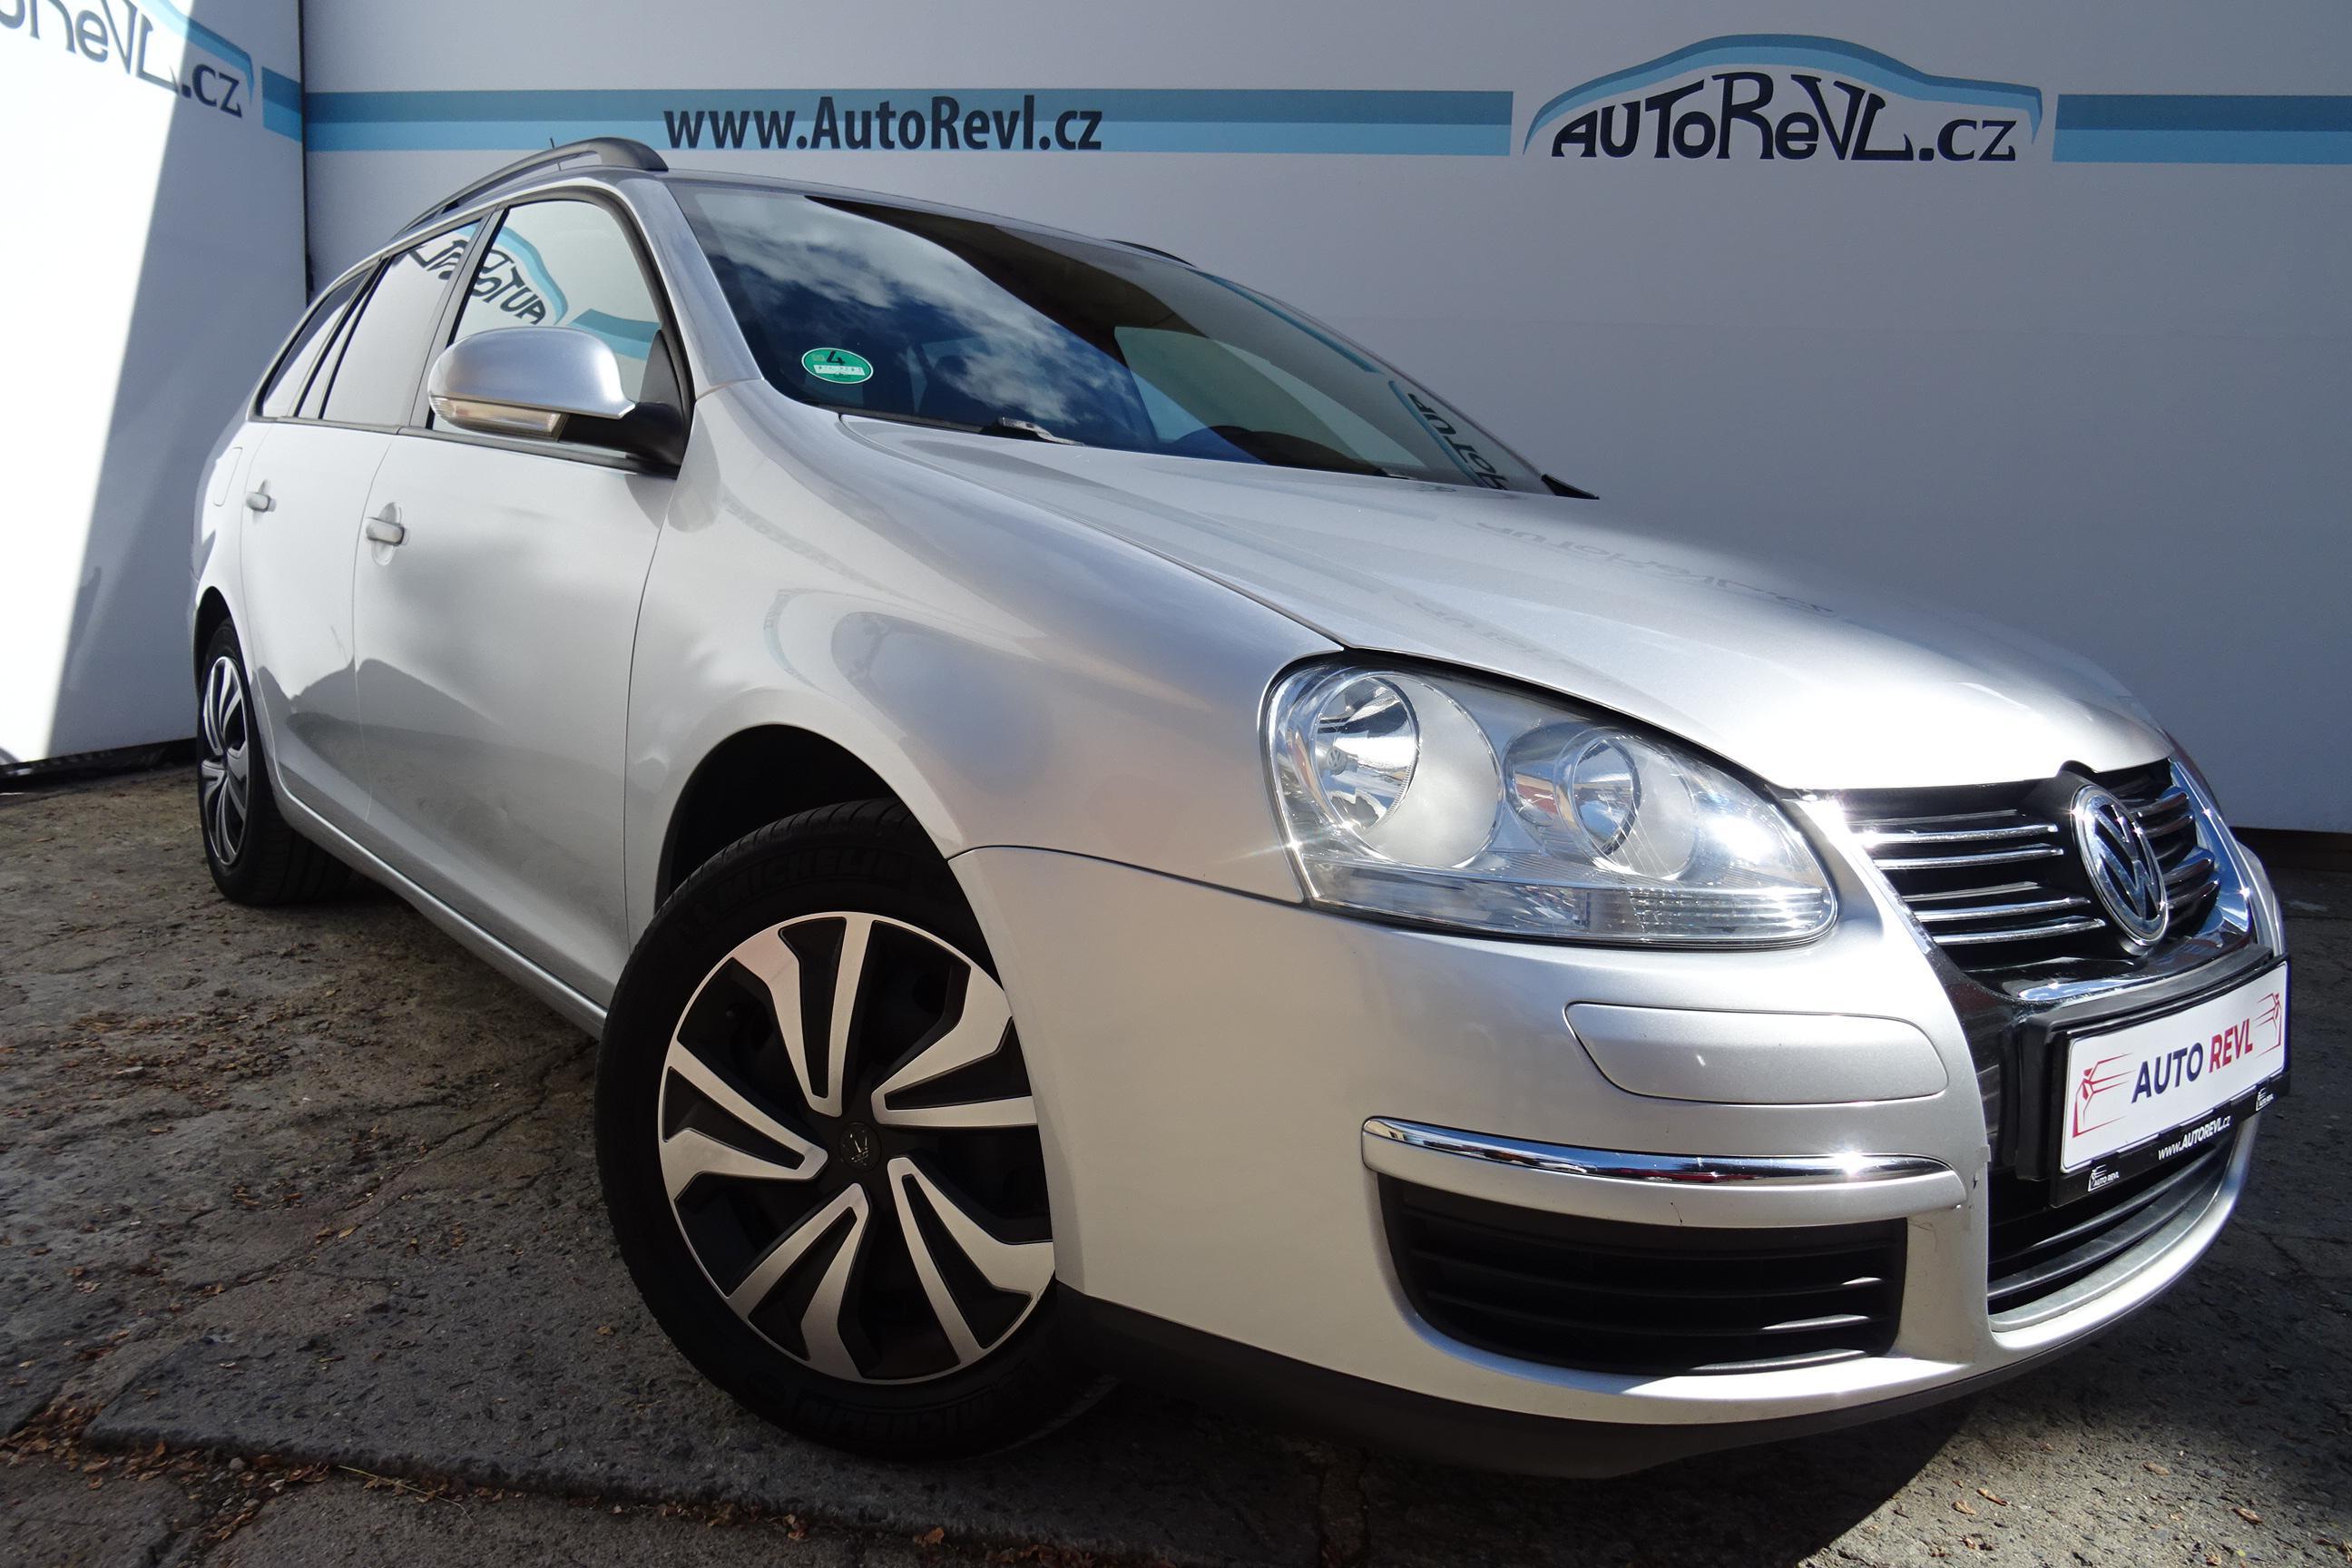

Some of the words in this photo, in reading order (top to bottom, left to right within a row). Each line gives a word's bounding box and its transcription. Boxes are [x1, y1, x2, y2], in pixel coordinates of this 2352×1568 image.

[663, 94, 1103, 151] www.AutoRevl.cz
[2131, 1042, 2204, 1104] AUTO
[2208, 1017, 2254, 1074] REVL
[2157, 1114, 2232, 1161] www.AUTOREVL.cz
